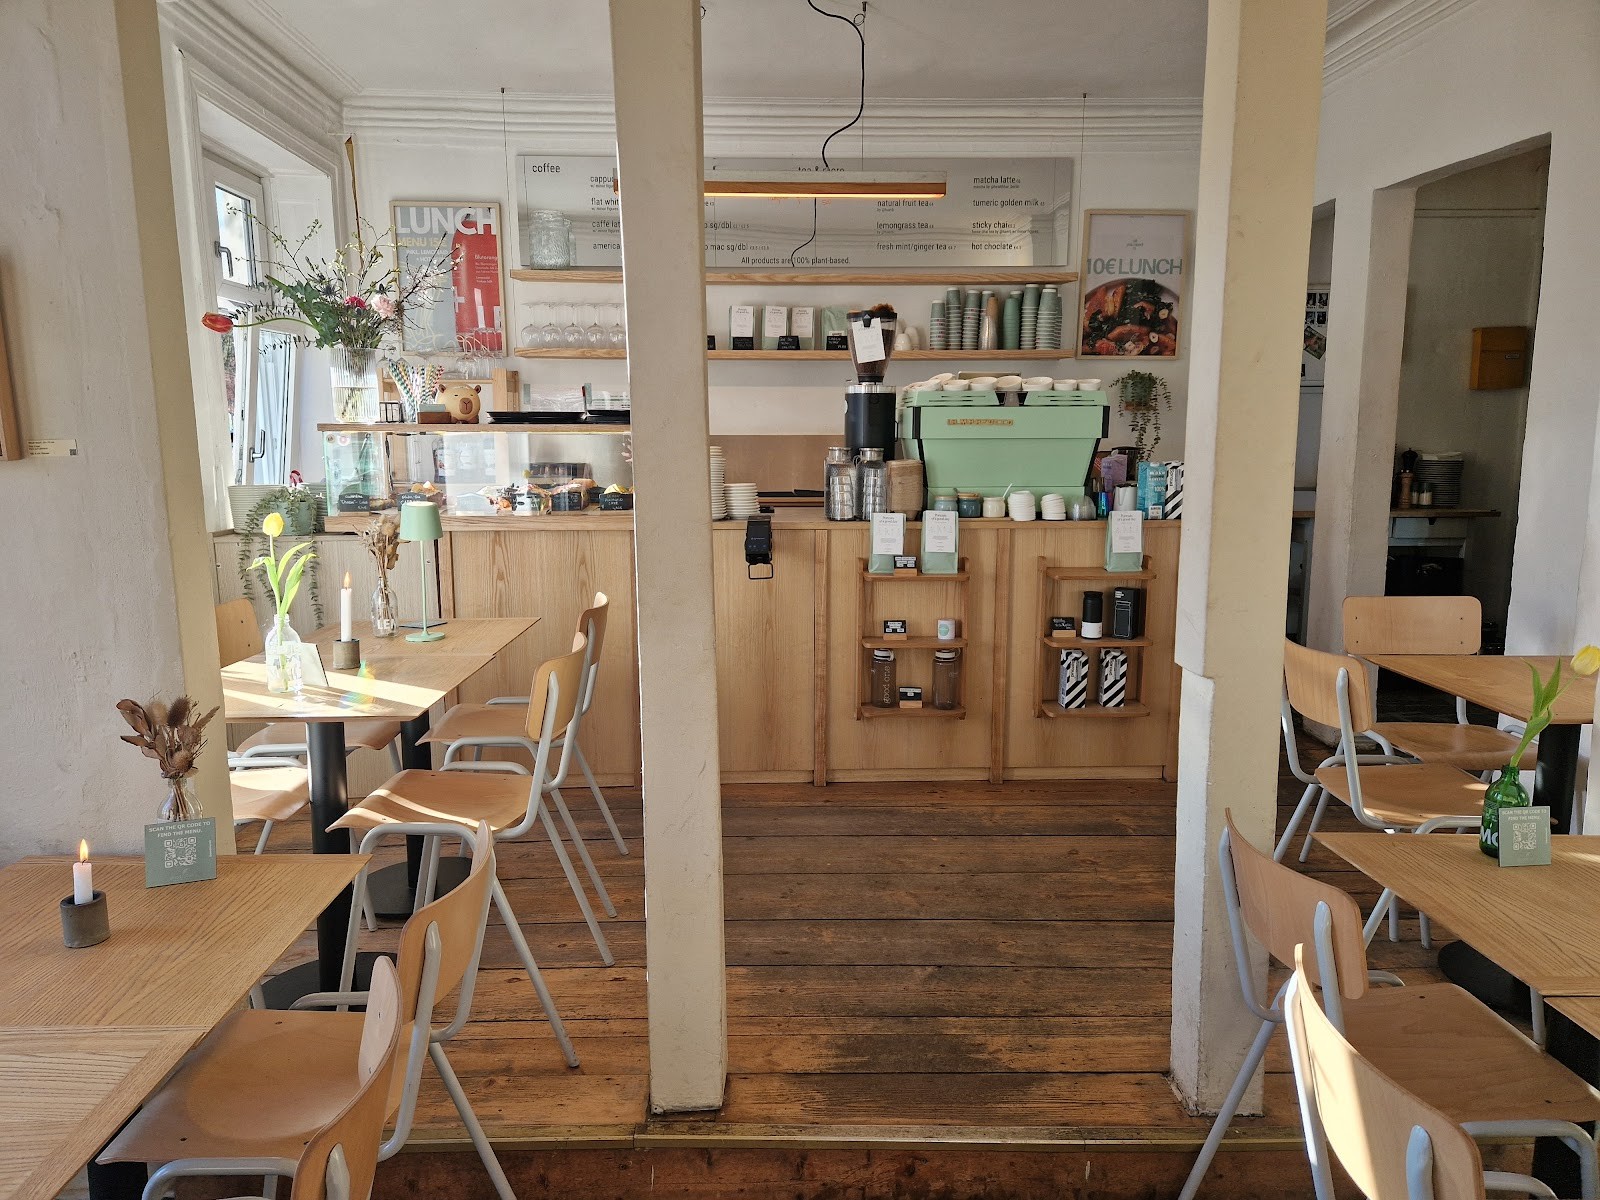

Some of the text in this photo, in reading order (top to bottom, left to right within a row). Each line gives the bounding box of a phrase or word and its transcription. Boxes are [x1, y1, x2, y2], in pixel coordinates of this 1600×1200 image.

[532, 162, 561, 173] coffee
[973, 176, 999, 184] matcha
[1000, 175, 1017, 184] latte
[591, 197, 603, 206] flat
[877, 199, 901, 207] natural
[902, 199, 917, 207] fruit
[972, 199, 999, 207] tumeric
[1000, 199, 1023, 208] golden
[1024, 199, 1039, 207] milk
[395, 207, 497, 236] LUNCH
[709, 220, 732, 231] sg/dbl
[876, 221, 916, 231] lemongrass
[917, 221, 929, 229] tea
[972, 221, 992, 230] sticky
[993, 221, 1008, 229] chai
[726, 243, 749, 253] sg/dbl
[876, 242, 894, 251] fresh
[895, 243, 935, 252] mint/ginger
[936, 243, 947, 251] tea
[971, 242, 982, 250] hot
[984, 242, 1013, 250] choclate
[751, 257, 780, 266] products
[1086, 258, 1183, 275] 10€ LUNCH
[883, 684, 892, 704] good
